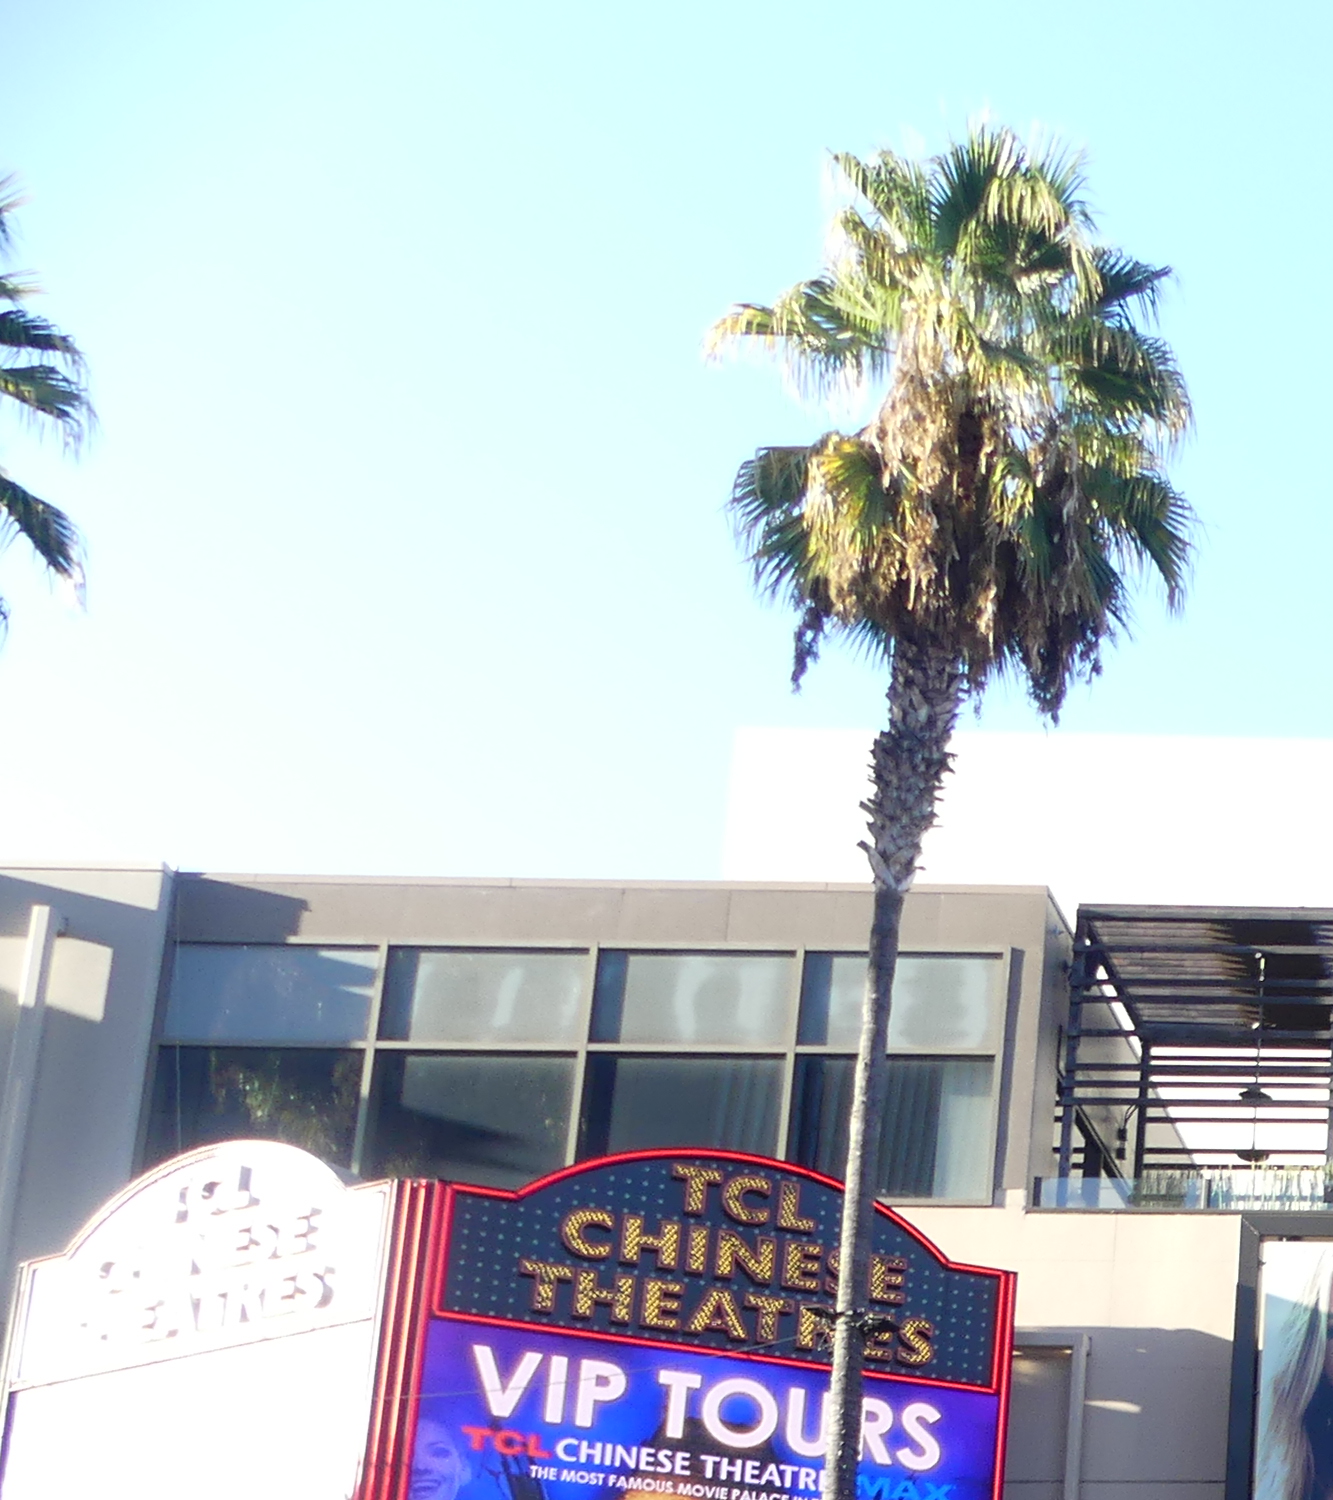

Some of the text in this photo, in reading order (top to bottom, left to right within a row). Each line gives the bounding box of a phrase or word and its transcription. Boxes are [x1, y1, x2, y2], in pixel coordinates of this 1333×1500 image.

[671, 1162, 816, 1232] TCL
[473, 1344, 941, 1470] VIP TOURS
[462, 1426, 552, 1458] TCL
[556, 1437, 691, 1477] CHINESE
[530, 1465, 557, 1481] THE
[561, 1469, 605, 1487] MOST
[608, 1474, 674, 1494] FAMOUS
[677, 1482, 728, 1500] MOVIE
